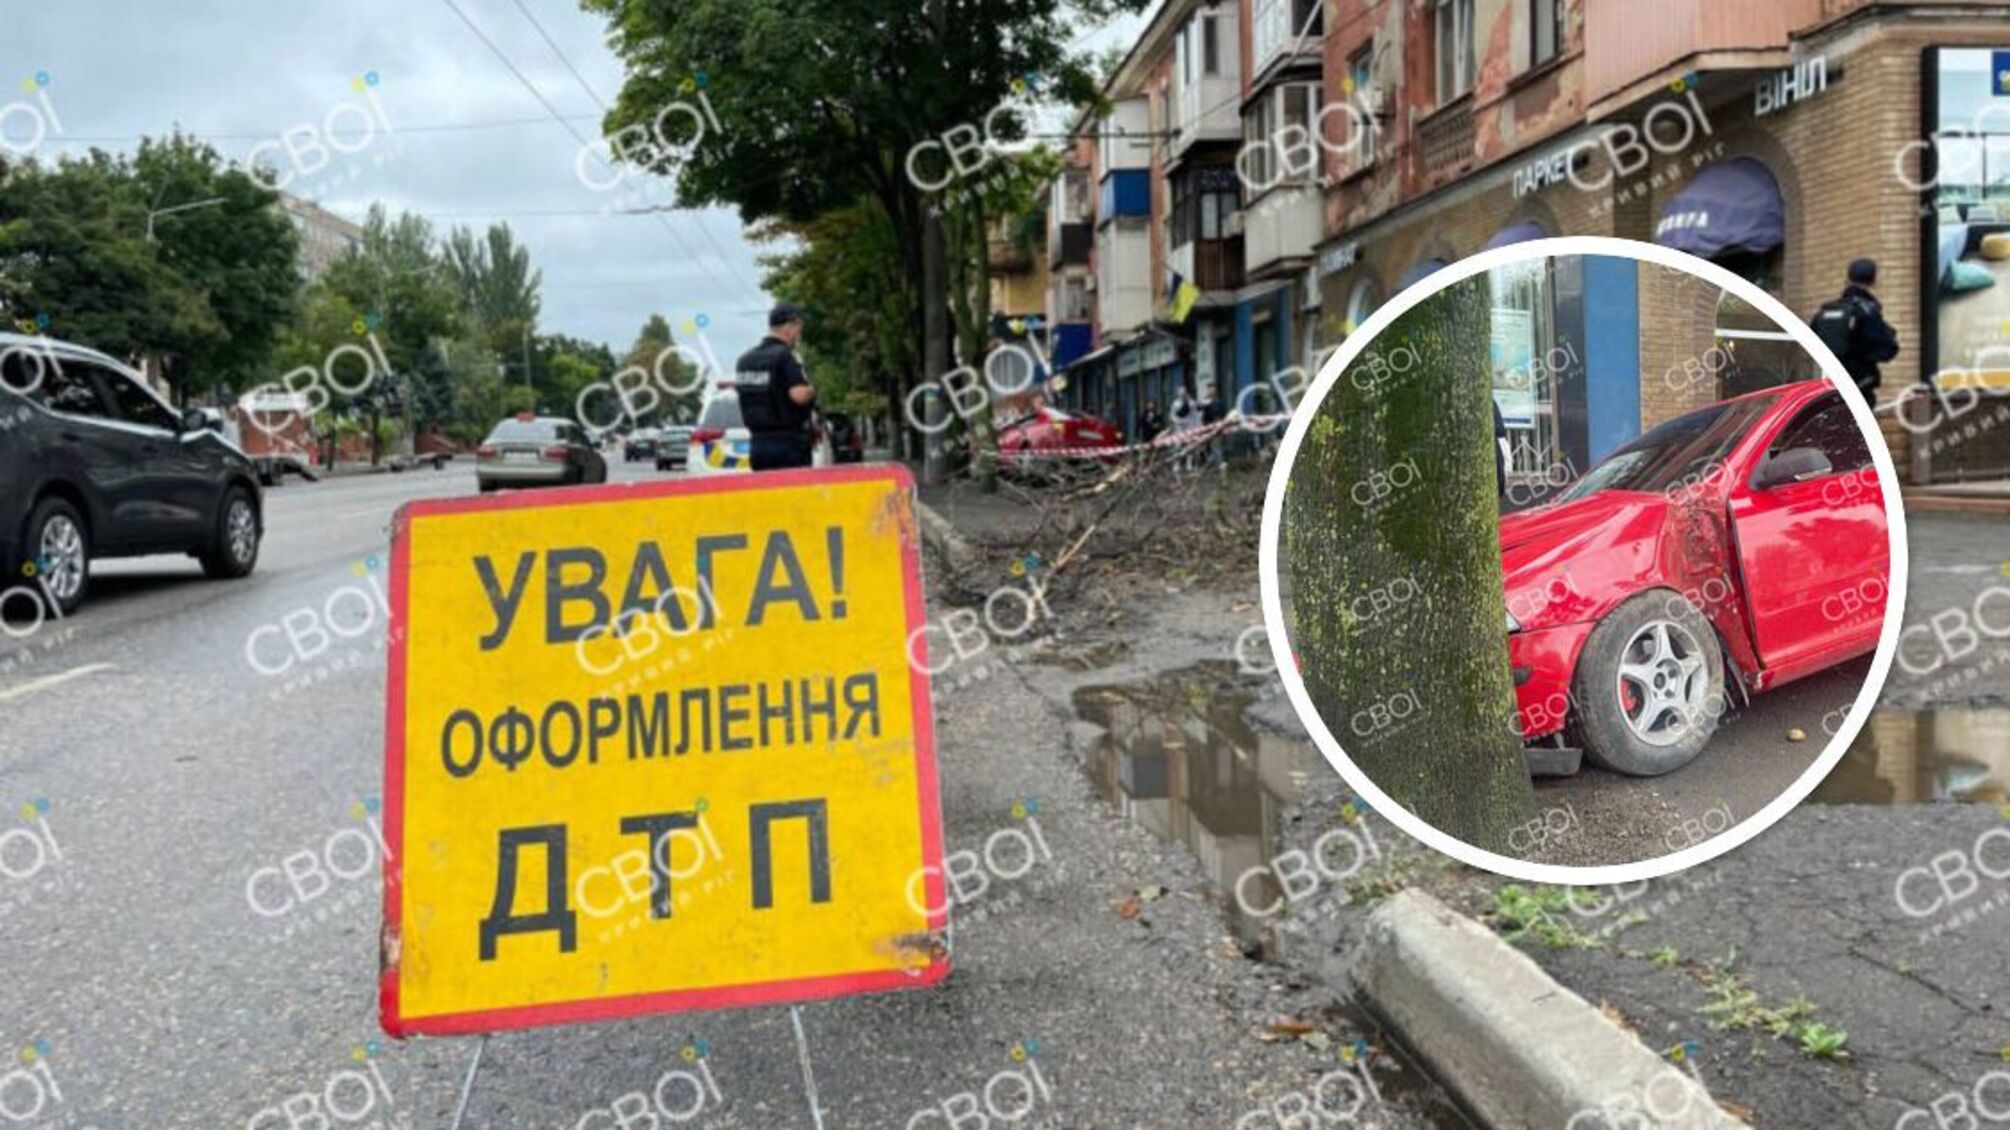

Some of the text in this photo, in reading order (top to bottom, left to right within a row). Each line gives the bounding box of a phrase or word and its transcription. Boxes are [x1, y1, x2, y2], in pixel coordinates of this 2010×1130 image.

[1754, 54, 1827, 117] ВІНІЛ
[473, 526, 847, 652] УВАГА!
[441, 672, 881, 779] ОФОРМЛЕННЯ
